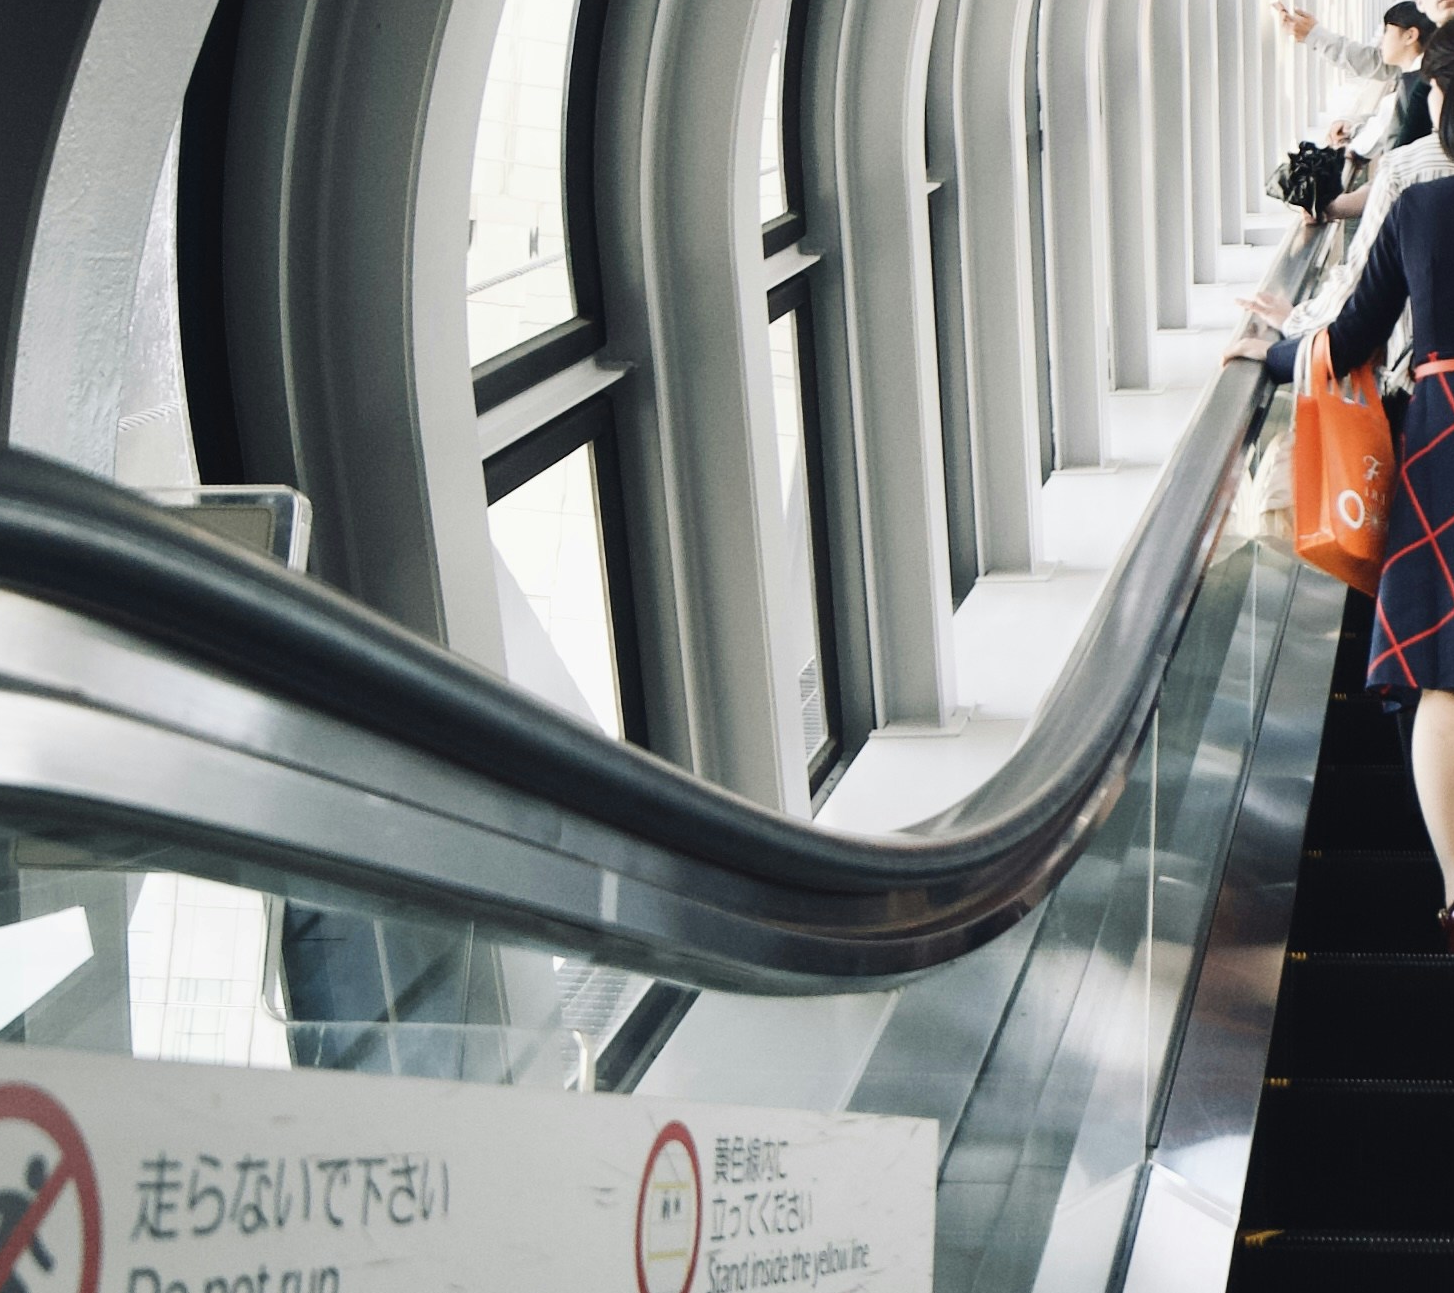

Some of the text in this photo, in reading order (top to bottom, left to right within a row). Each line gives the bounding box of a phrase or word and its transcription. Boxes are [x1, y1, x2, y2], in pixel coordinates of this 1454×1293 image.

[129, 1150, 449, 1242] 走らないで下さい
[711, 1190, 813, 1241] 立ってください
[751, 1251, 788, 1287] inside
[792, 1249, 810, 1280] the
[812, 1241, 847, 1288] yellow
